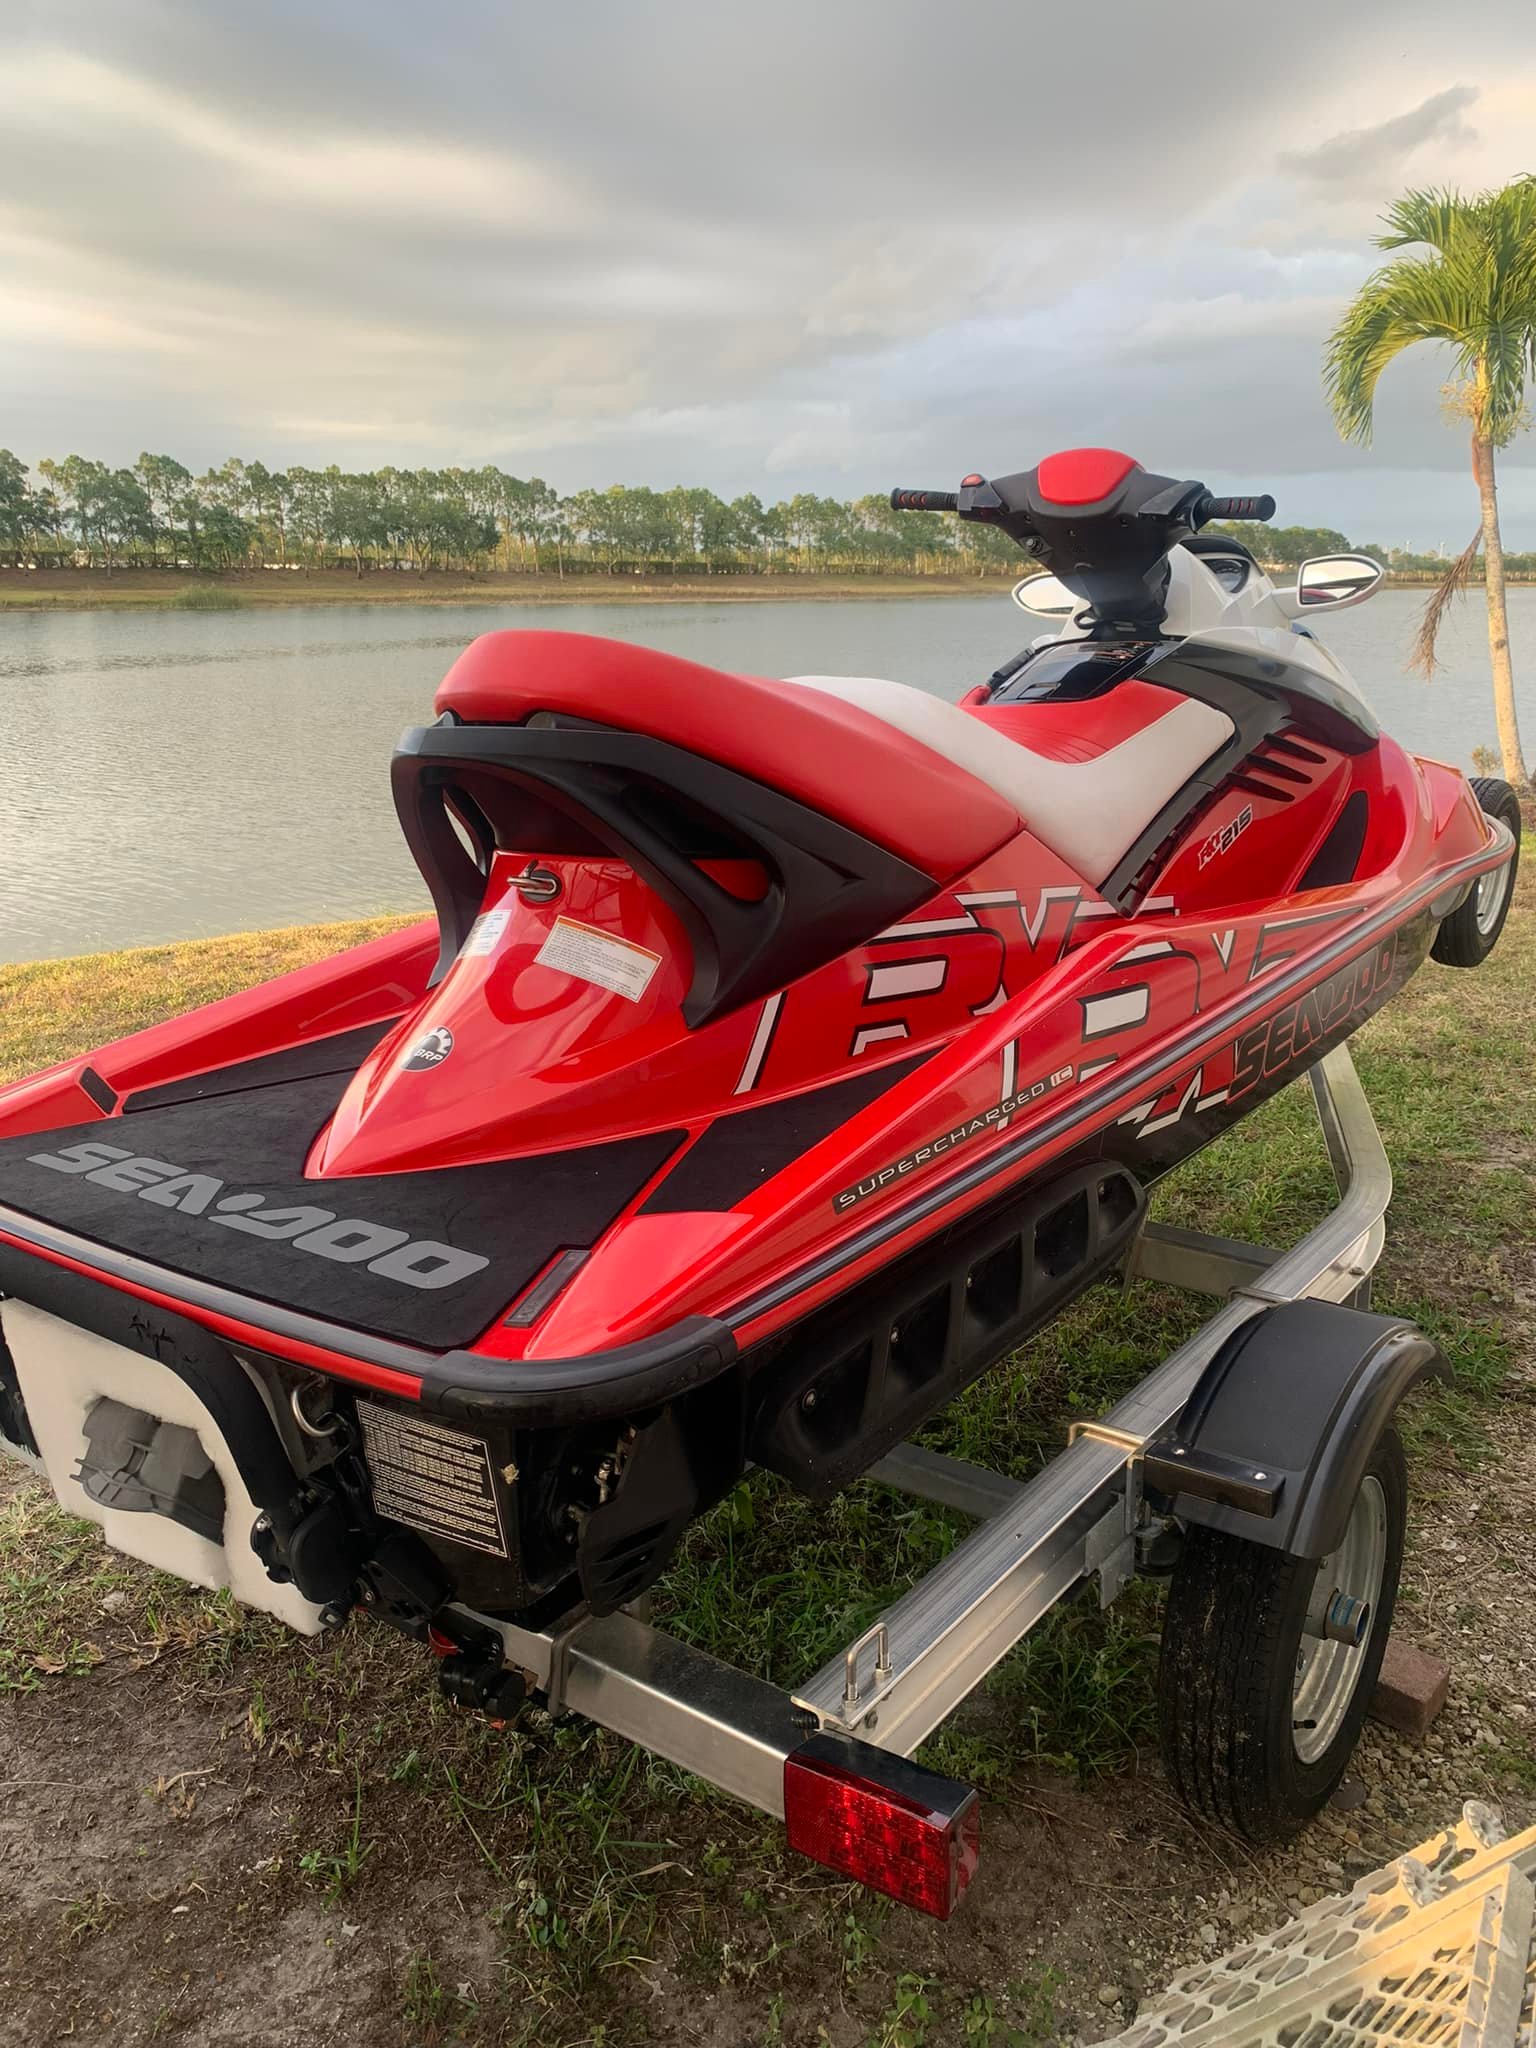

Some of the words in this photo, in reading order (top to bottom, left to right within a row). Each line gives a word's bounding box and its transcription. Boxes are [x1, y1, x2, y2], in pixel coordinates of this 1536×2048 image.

[1220, 803, 1253, 855] 215
[414, 1048, 444, 1062] BRP
[838, 1081, 1046, 1210] SUPERCHARGED
